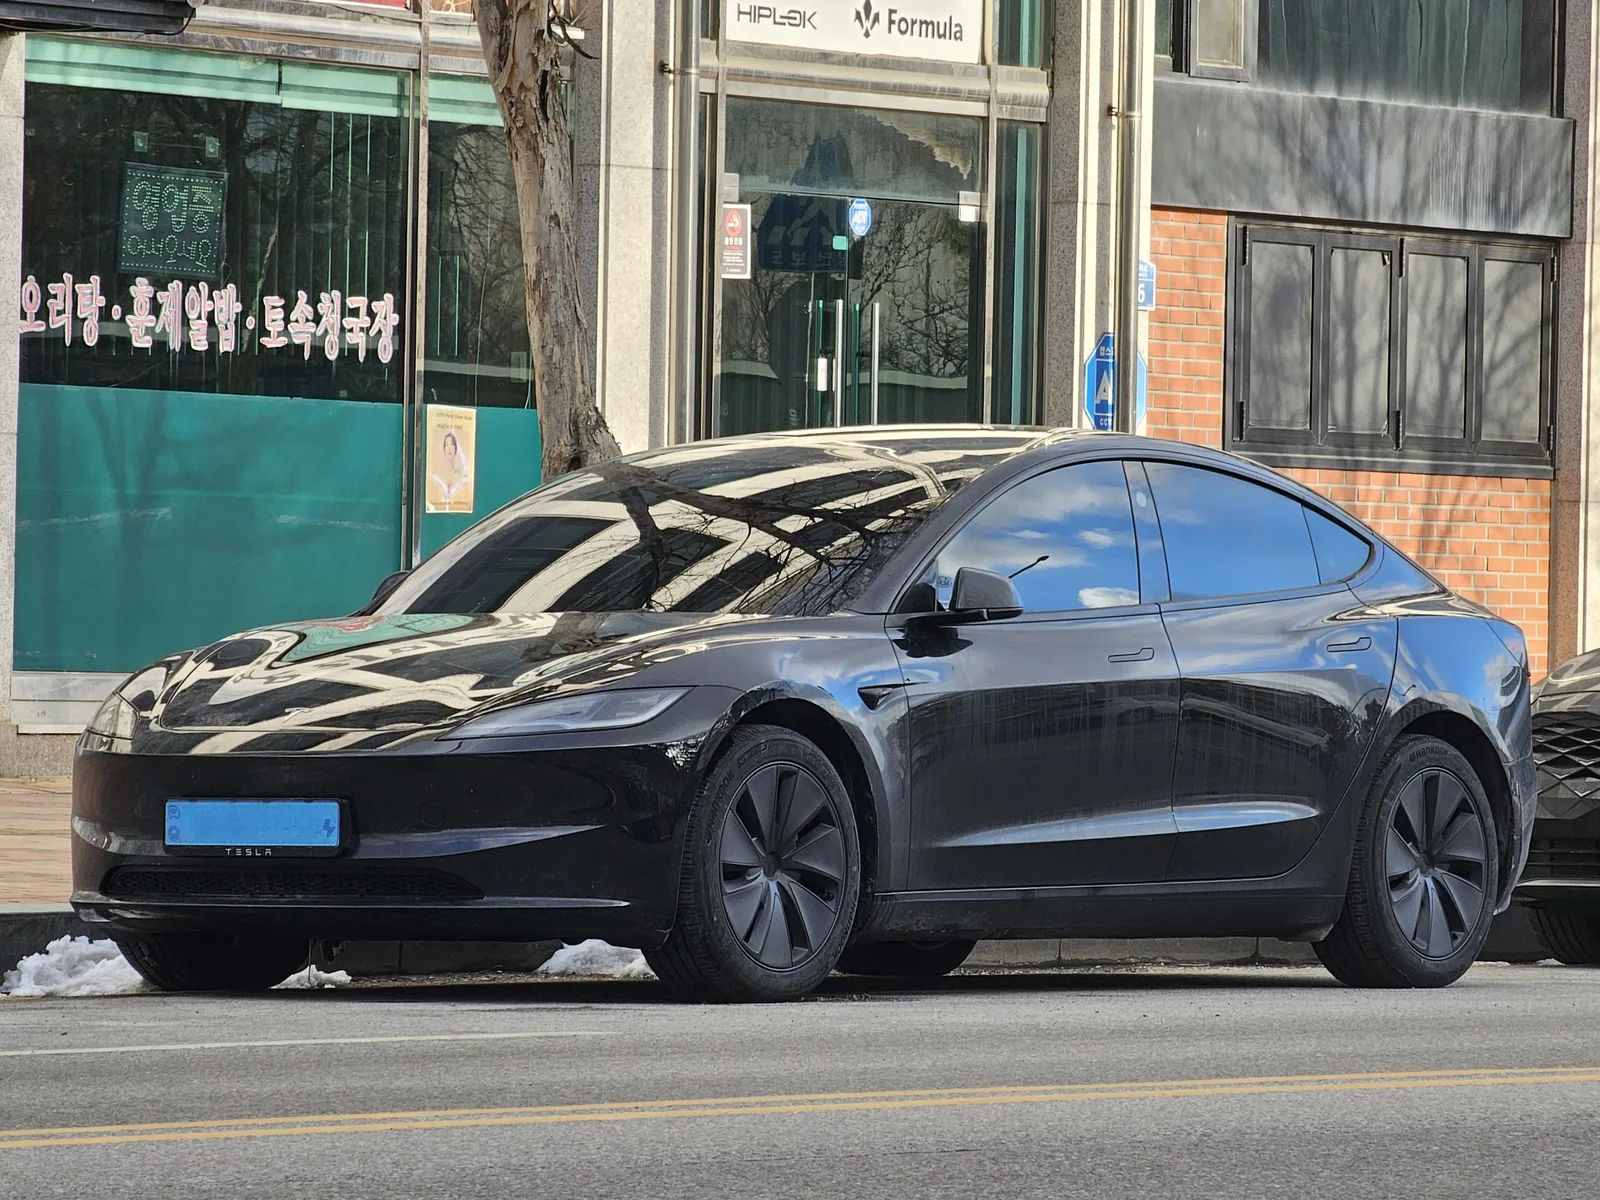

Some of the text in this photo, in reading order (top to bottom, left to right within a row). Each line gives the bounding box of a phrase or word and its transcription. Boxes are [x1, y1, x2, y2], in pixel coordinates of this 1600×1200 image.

[887, 8, 963, 42] Formula
[132, 180, 214, 234] 영업중
[127, 234, 212, 268] 어서오세요
[19, 272, 399, 364] 오리탕 훈제알밥 토속청국장
[1099, 345, 1113, 357] 캡스
[1099, 418, 1113, 427] CCT
[225, 848, 272, 856] TESLA
